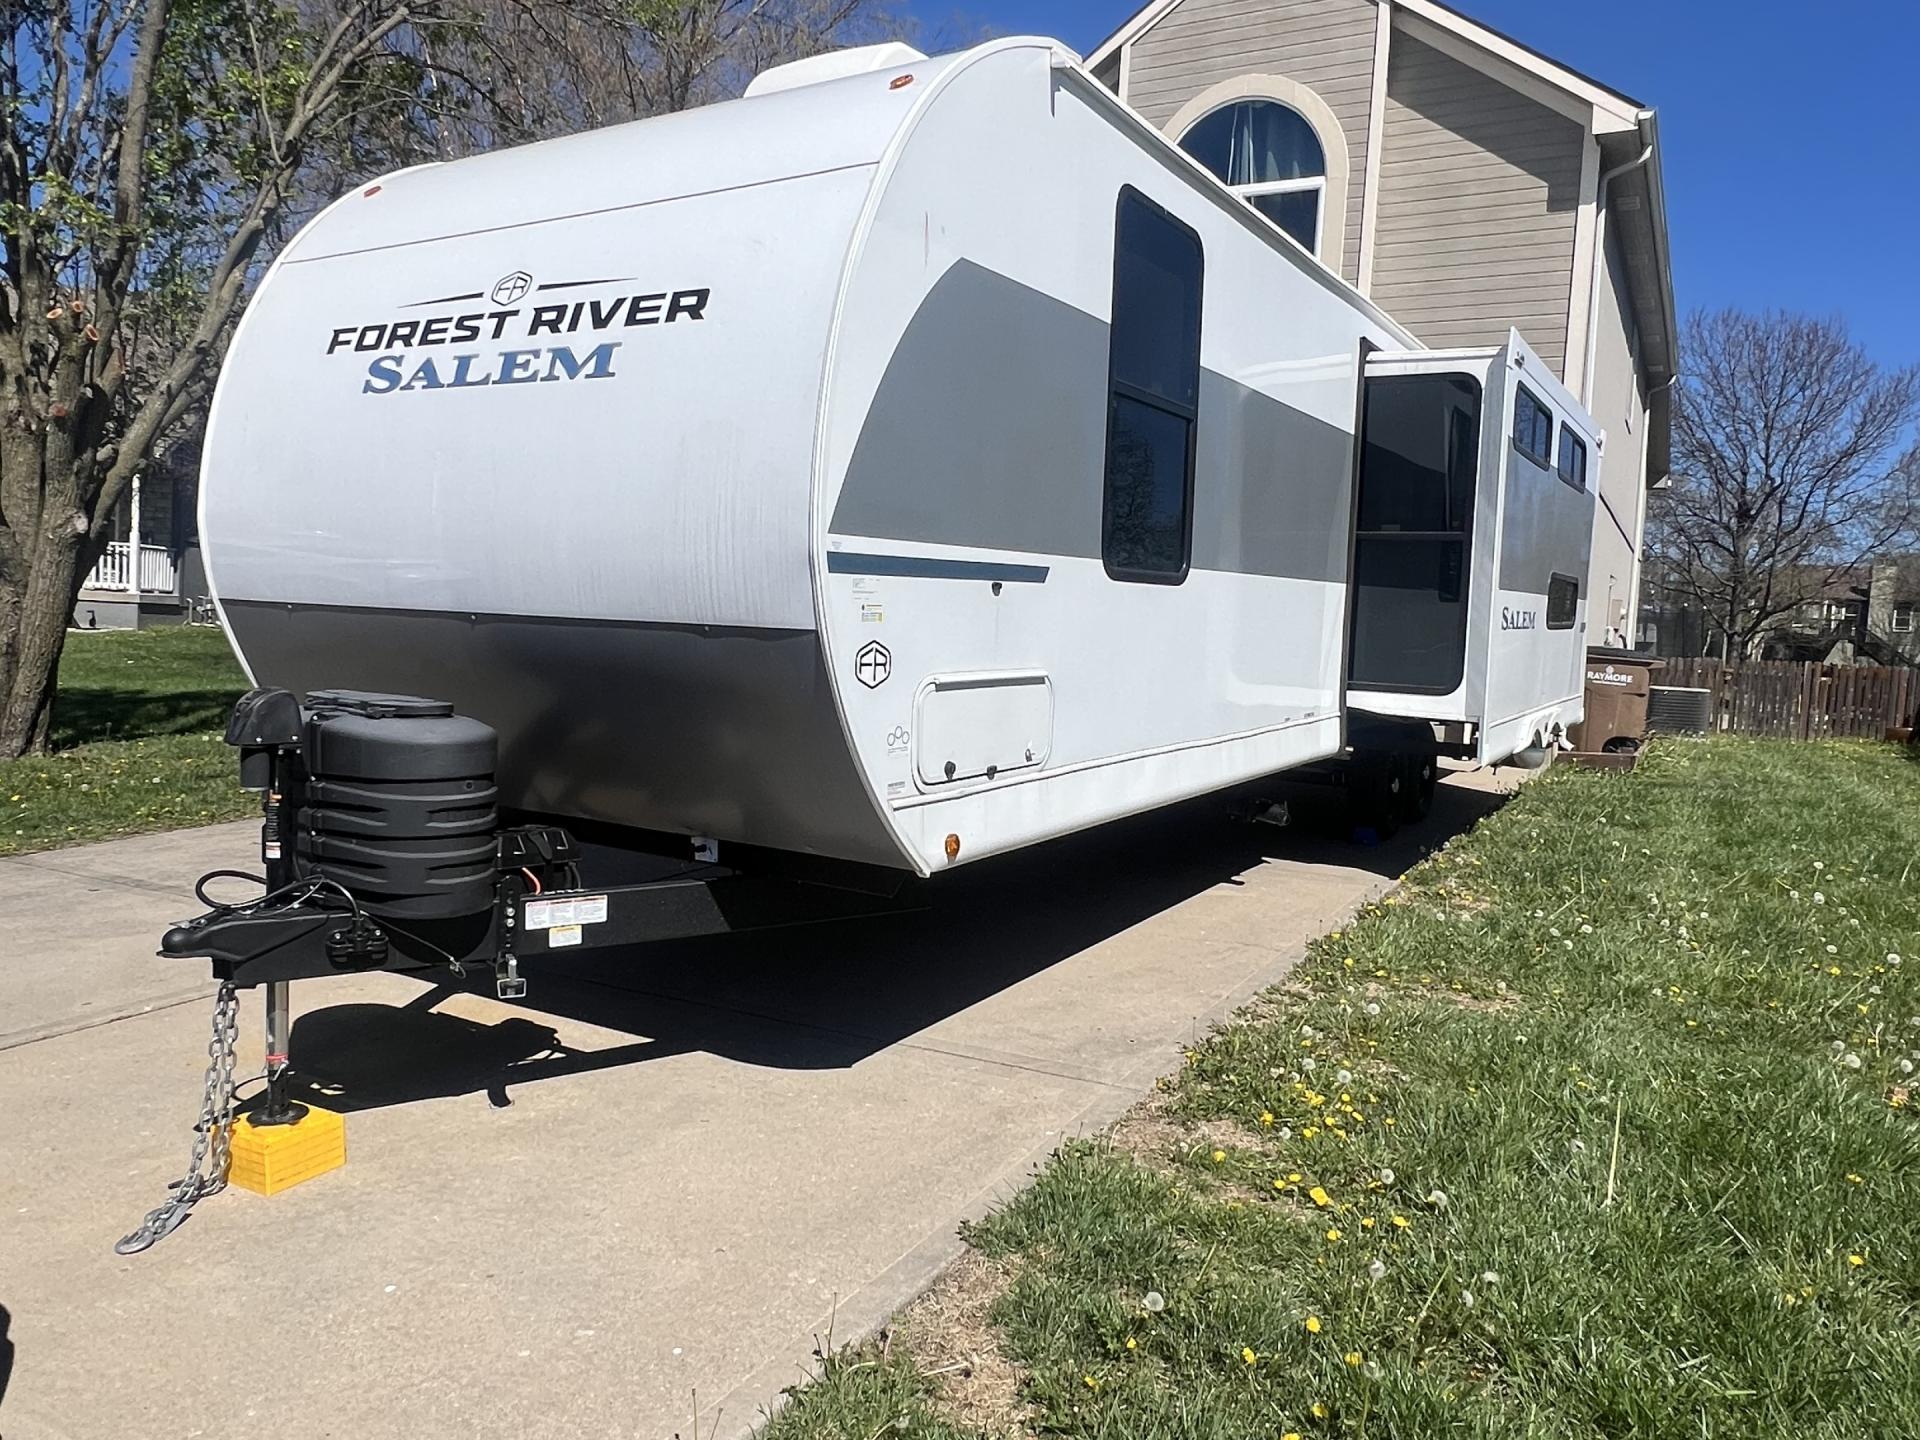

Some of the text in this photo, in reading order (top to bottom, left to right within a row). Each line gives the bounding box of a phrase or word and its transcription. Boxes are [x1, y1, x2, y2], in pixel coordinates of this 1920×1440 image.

[326, 288, 710, 354] FOREST RIVER
[362, 342, 622, 394] SALEM
[1587, 671, 1633, 683] RAYMORE
